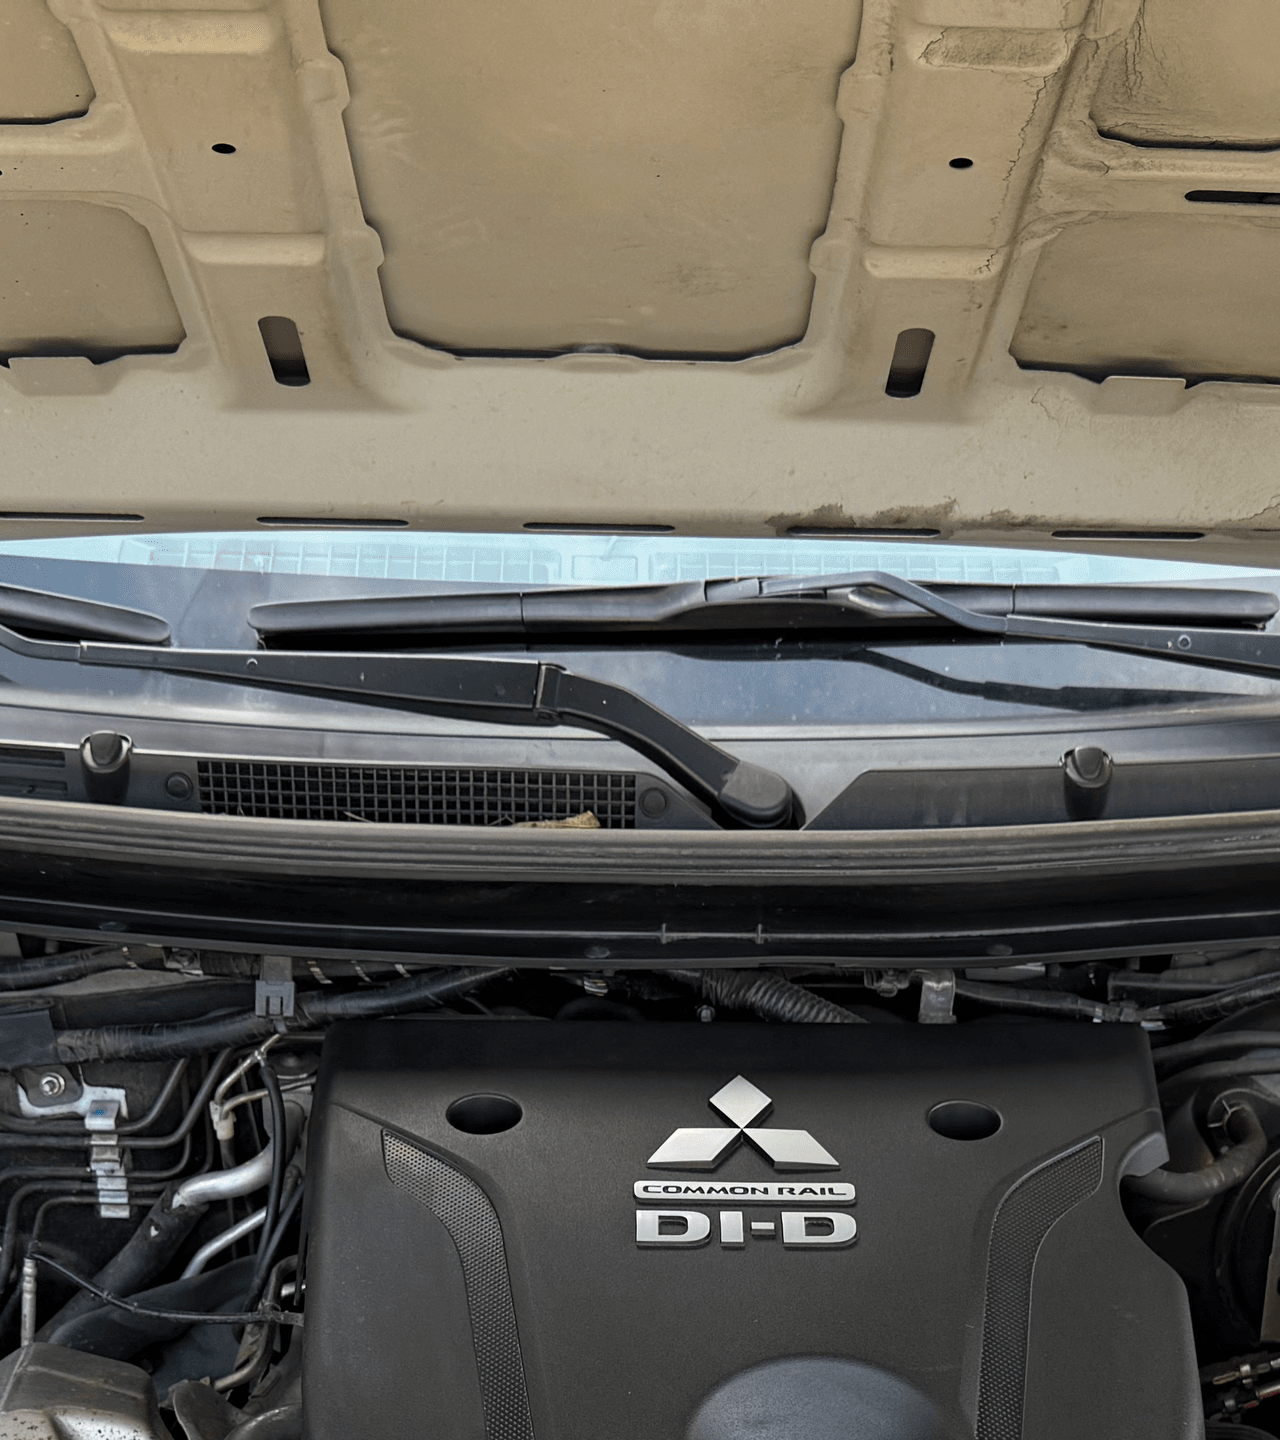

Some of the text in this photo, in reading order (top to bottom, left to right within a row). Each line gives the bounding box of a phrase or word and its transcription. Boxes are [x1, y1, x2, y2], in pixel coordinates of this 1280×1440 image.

[642, 1185, 847, 1196] COMMON RAIL
[635, 1209, 858, 1245] DI-D
